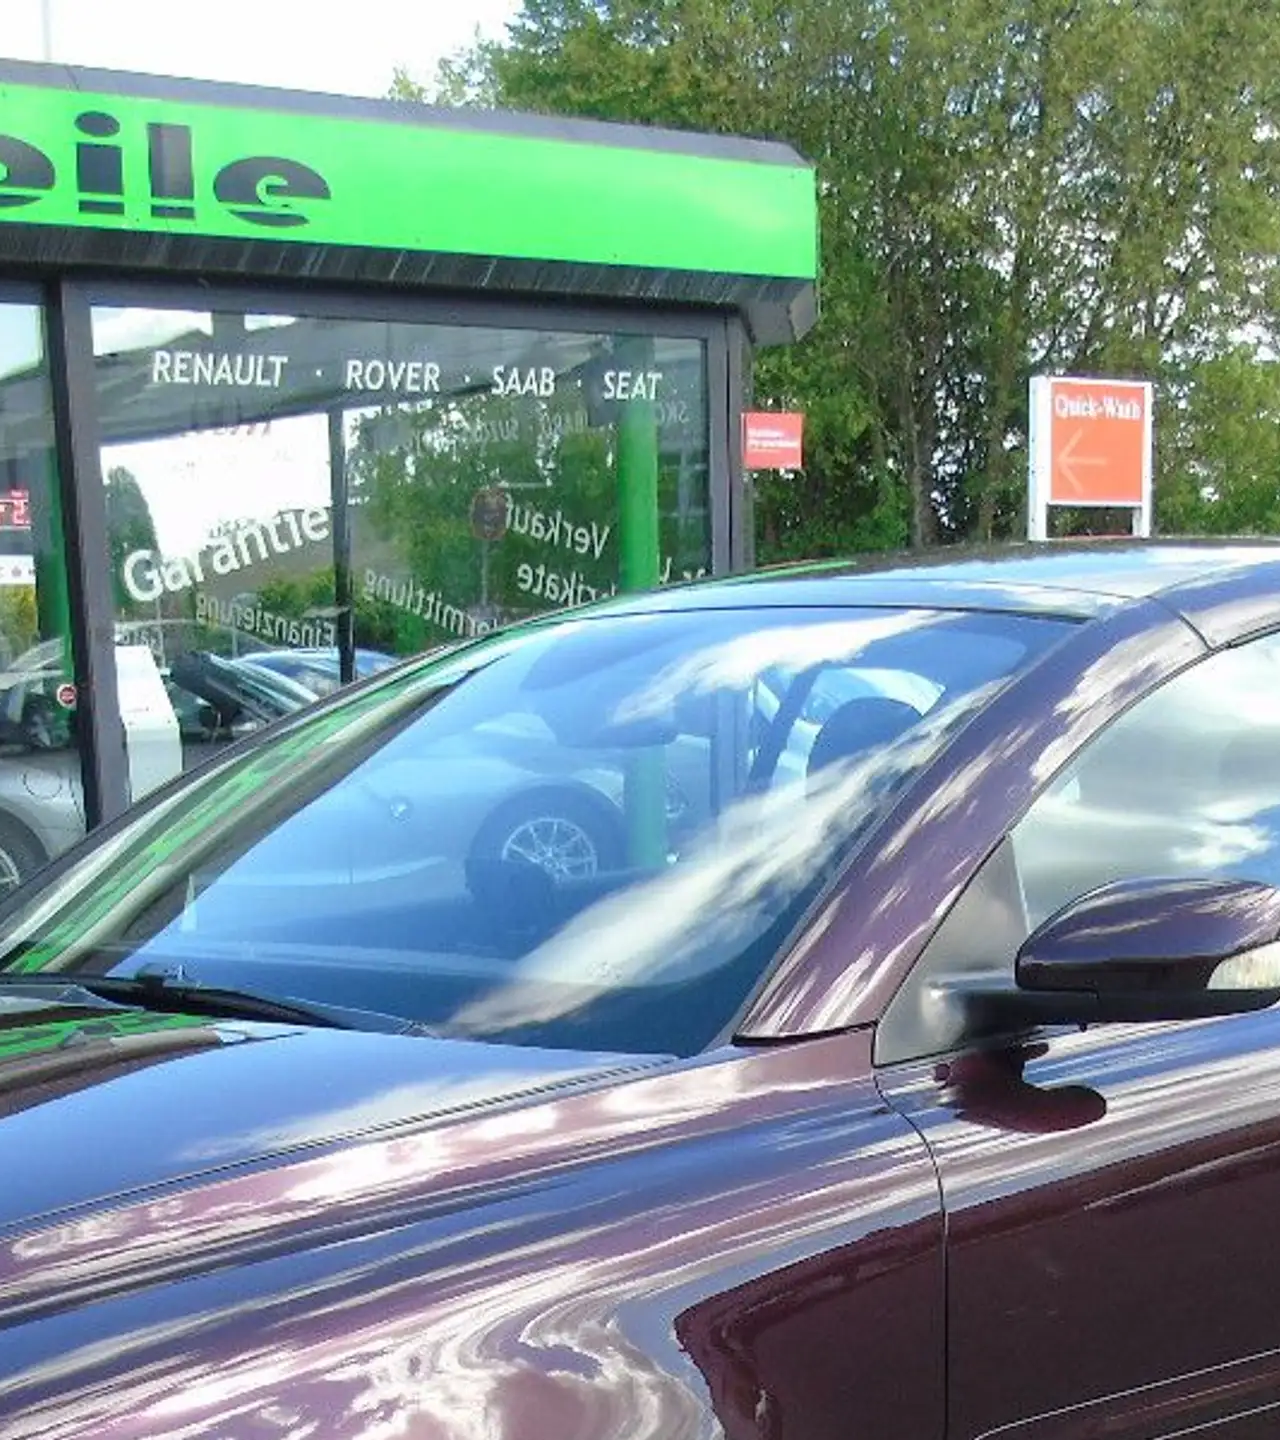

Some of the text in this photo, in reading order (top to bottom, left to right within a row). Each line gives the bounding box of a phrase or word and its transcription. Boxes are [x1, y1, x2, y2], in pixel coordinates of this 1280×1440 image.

[152, 350, 662, 401] RENAULT ROVER SAAB SEAT
[123, 506, 330, 602] Garantie
